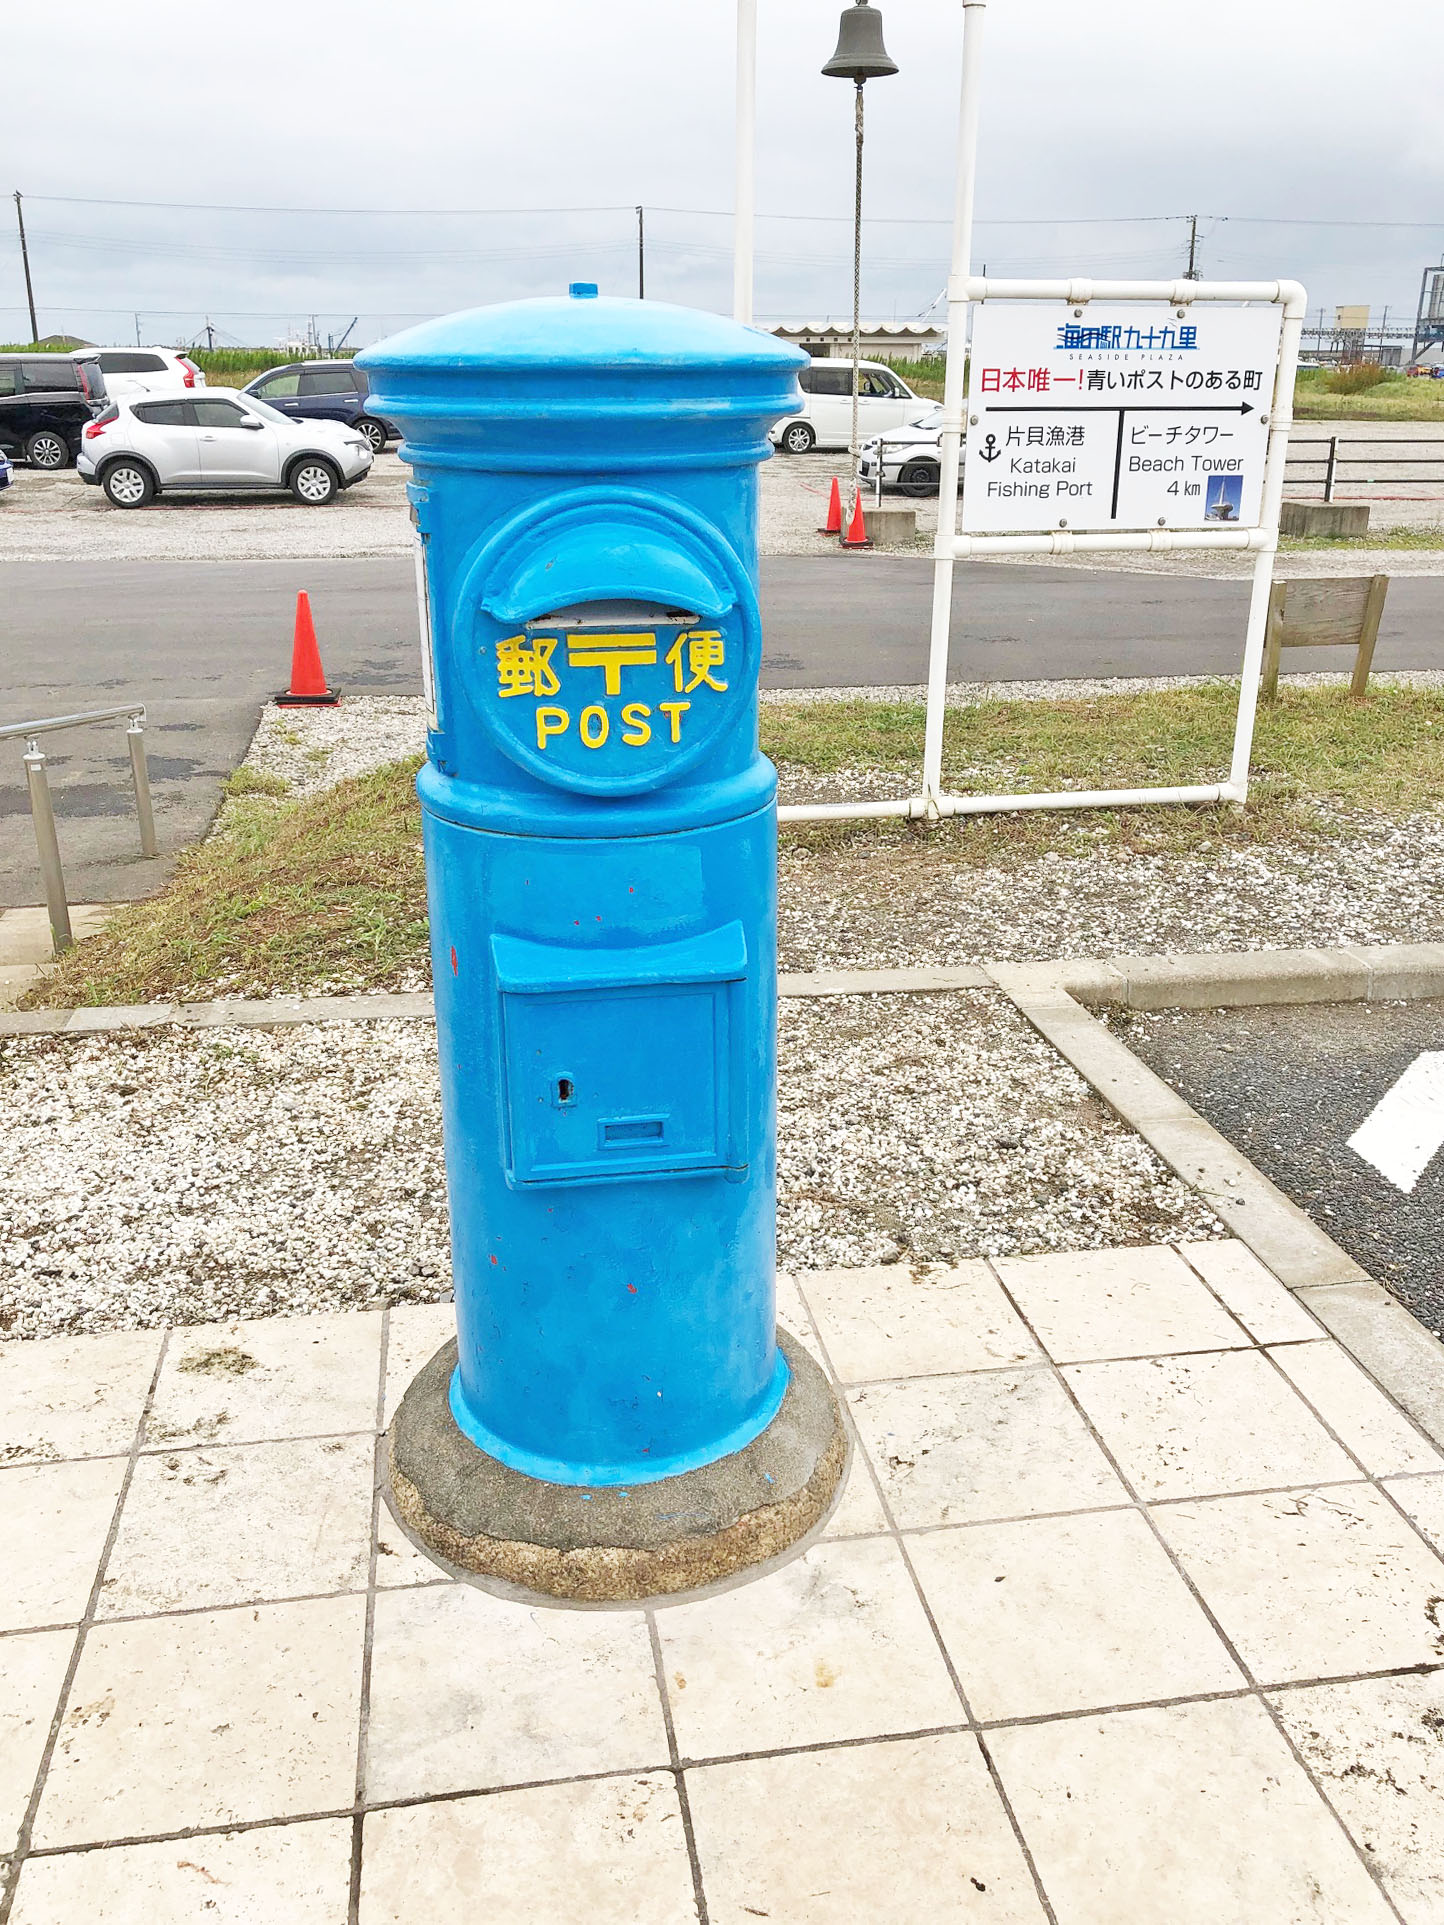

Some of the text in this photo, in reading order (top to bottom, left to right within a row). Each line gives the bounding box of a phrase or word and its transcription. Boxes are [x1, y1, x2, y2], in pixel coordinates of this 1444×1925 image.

[1069, 353, 1184, 361] SEASIDE PLAZA
[1005, 426, 1085, 447] 片貝漁港
[1131, 426, 1233, 445] ビーチタワー
[1010, 457, 1076, 474] Katakai
[1128, 456, 1244, 472] Beach Tower
[987, 481, 1093, 499] Fishing Port
[1166, 481, 1201, 496] 4 km
[536, 702, 691, 749] POST
